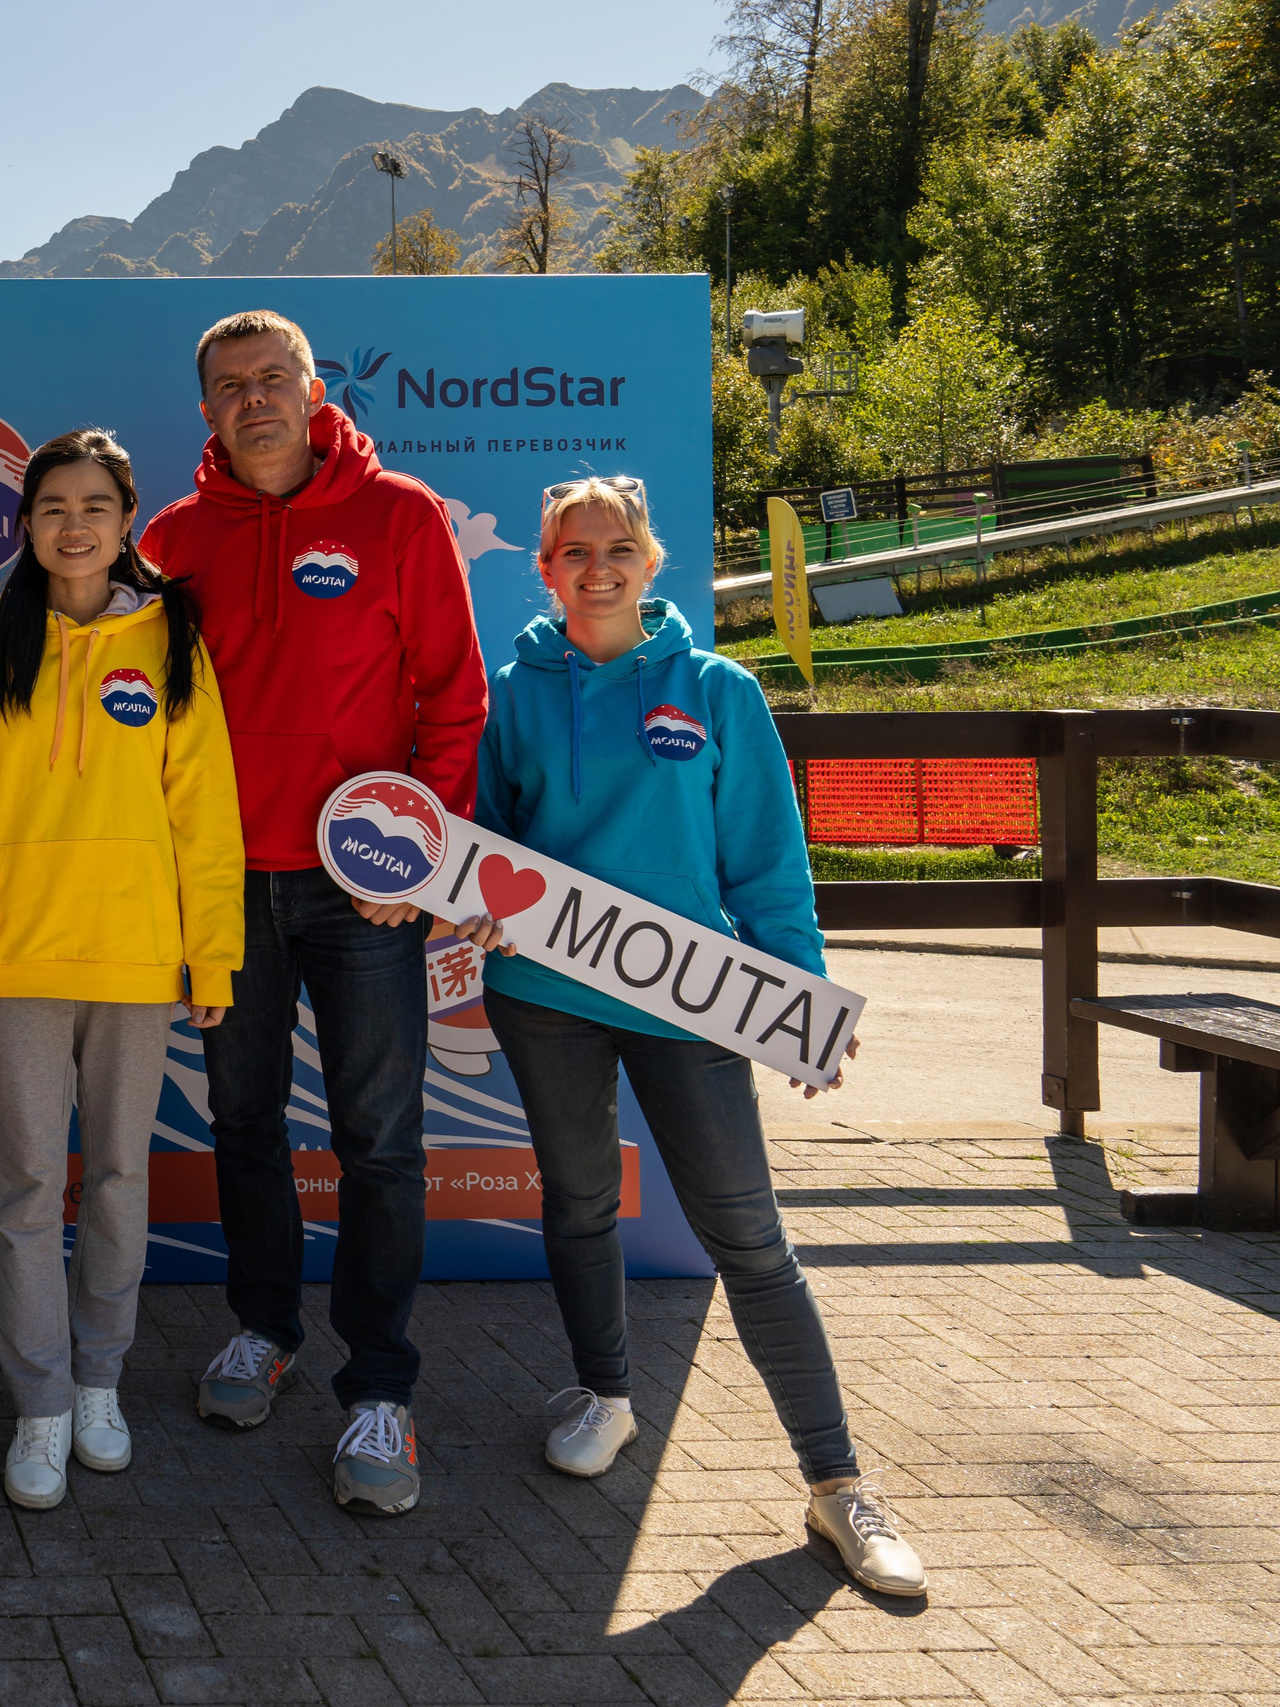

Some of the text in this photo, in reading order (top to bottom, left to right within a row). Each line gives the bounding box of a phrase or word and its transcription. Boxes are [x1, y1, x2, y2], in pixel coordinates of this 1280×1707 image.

[397, 367, 626, 408] NordStar
[373, 436, 627, 454] ИАЛЬНЫЙ ПЕРЕВОЗЧИК
[302, 574, 346, 588] MOUTAI
[113, 701, 151, 715] MOUTAI
[650, 736, 696, 750] MOUTAI
[340, 836, 413, 880] MOUTAI
[446, 842, 851, 1071] I MOUTAI
[451, 1172, 519, 1190] «Роза
